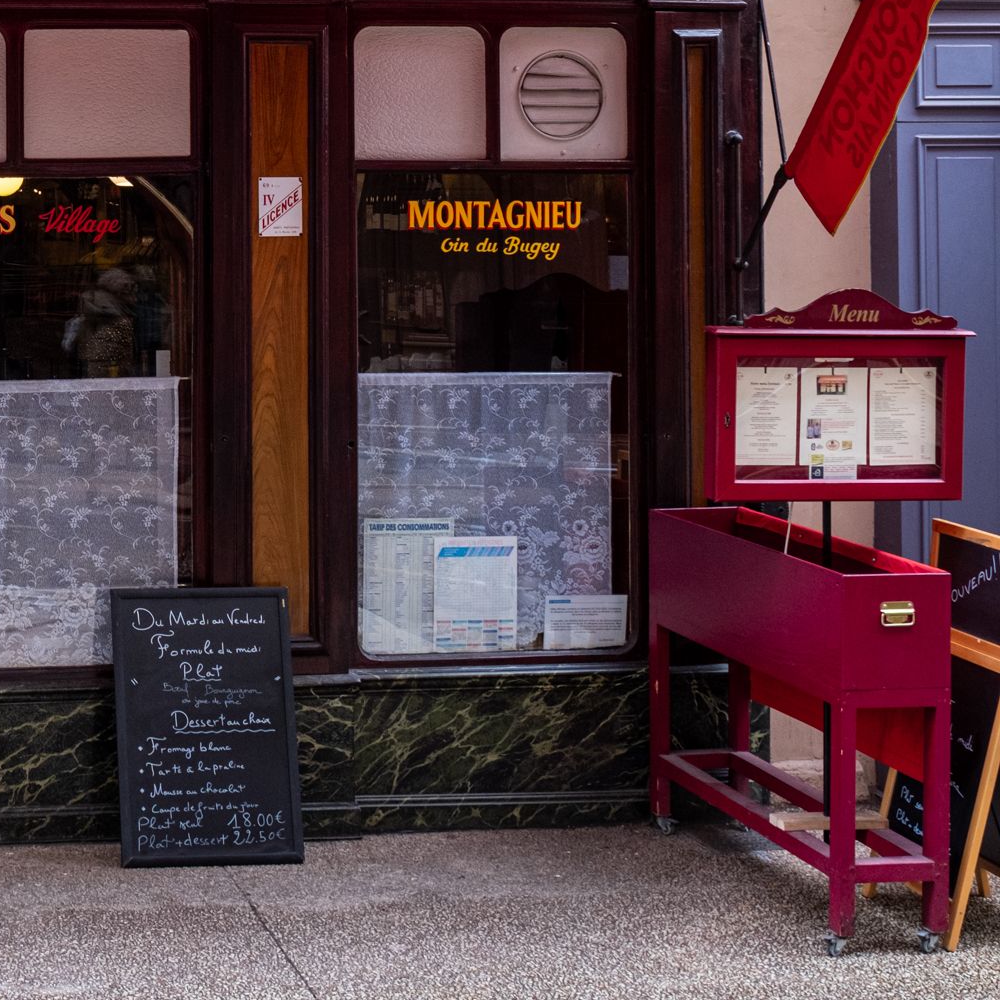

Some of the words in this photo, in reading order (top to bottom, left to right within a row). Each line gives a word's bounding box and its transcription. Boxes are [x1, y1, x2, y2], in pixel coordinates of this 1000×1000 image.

[262, 190, 300, 229] LICENCE
[263, 194, 275, 206] IV
[40, 205, 122, 244] Village
[406, 199, 584, 231] MONTAGNIEU
[475, 237, 499, 253] du
[503, 236, 561, 261] Bugey
[828, 304, 880, 324] Menu
[369, 523, 385, 531] TARIF
[386, 523, 396, 531] DES
[397, 522, 450, 531] CONSOMMATIONS
[951, 554, 999, 603] OUVEAU!
[132, 607, 164, 630] Du
[169, 610, 209, 626] Mardi
[212, 616, 225, 625] au
[226, 608, 266, 626] Vendredi
[151, 630, 214, 659] Formule
[217, 641, 232, 655] du
[236, 643, 262, 655] midi
[179, 662, 223, 680] Plat
[171, 710, 226, 731] Dessert
[227, 717, 240, 727] au
[242, 711, 272, 726] choix
[146, 737, 195, 759] Fromage
[199, 741, 232, 753] blanc
[146, 761, 182, 777] Tarte
[198, 760, 211, 771] la
[211, 761, 246, 776] praline
[151, 783, 183, 799] Mousse
[186, 788, 199, 797] au
[201, 780, 247, 795] chocolat
[152, 804, 181, 820] Coupe
[184, 801, 196, 812] de
[138, 815, 176, 833] Plat
[138, 834, 176, 853] Plat
